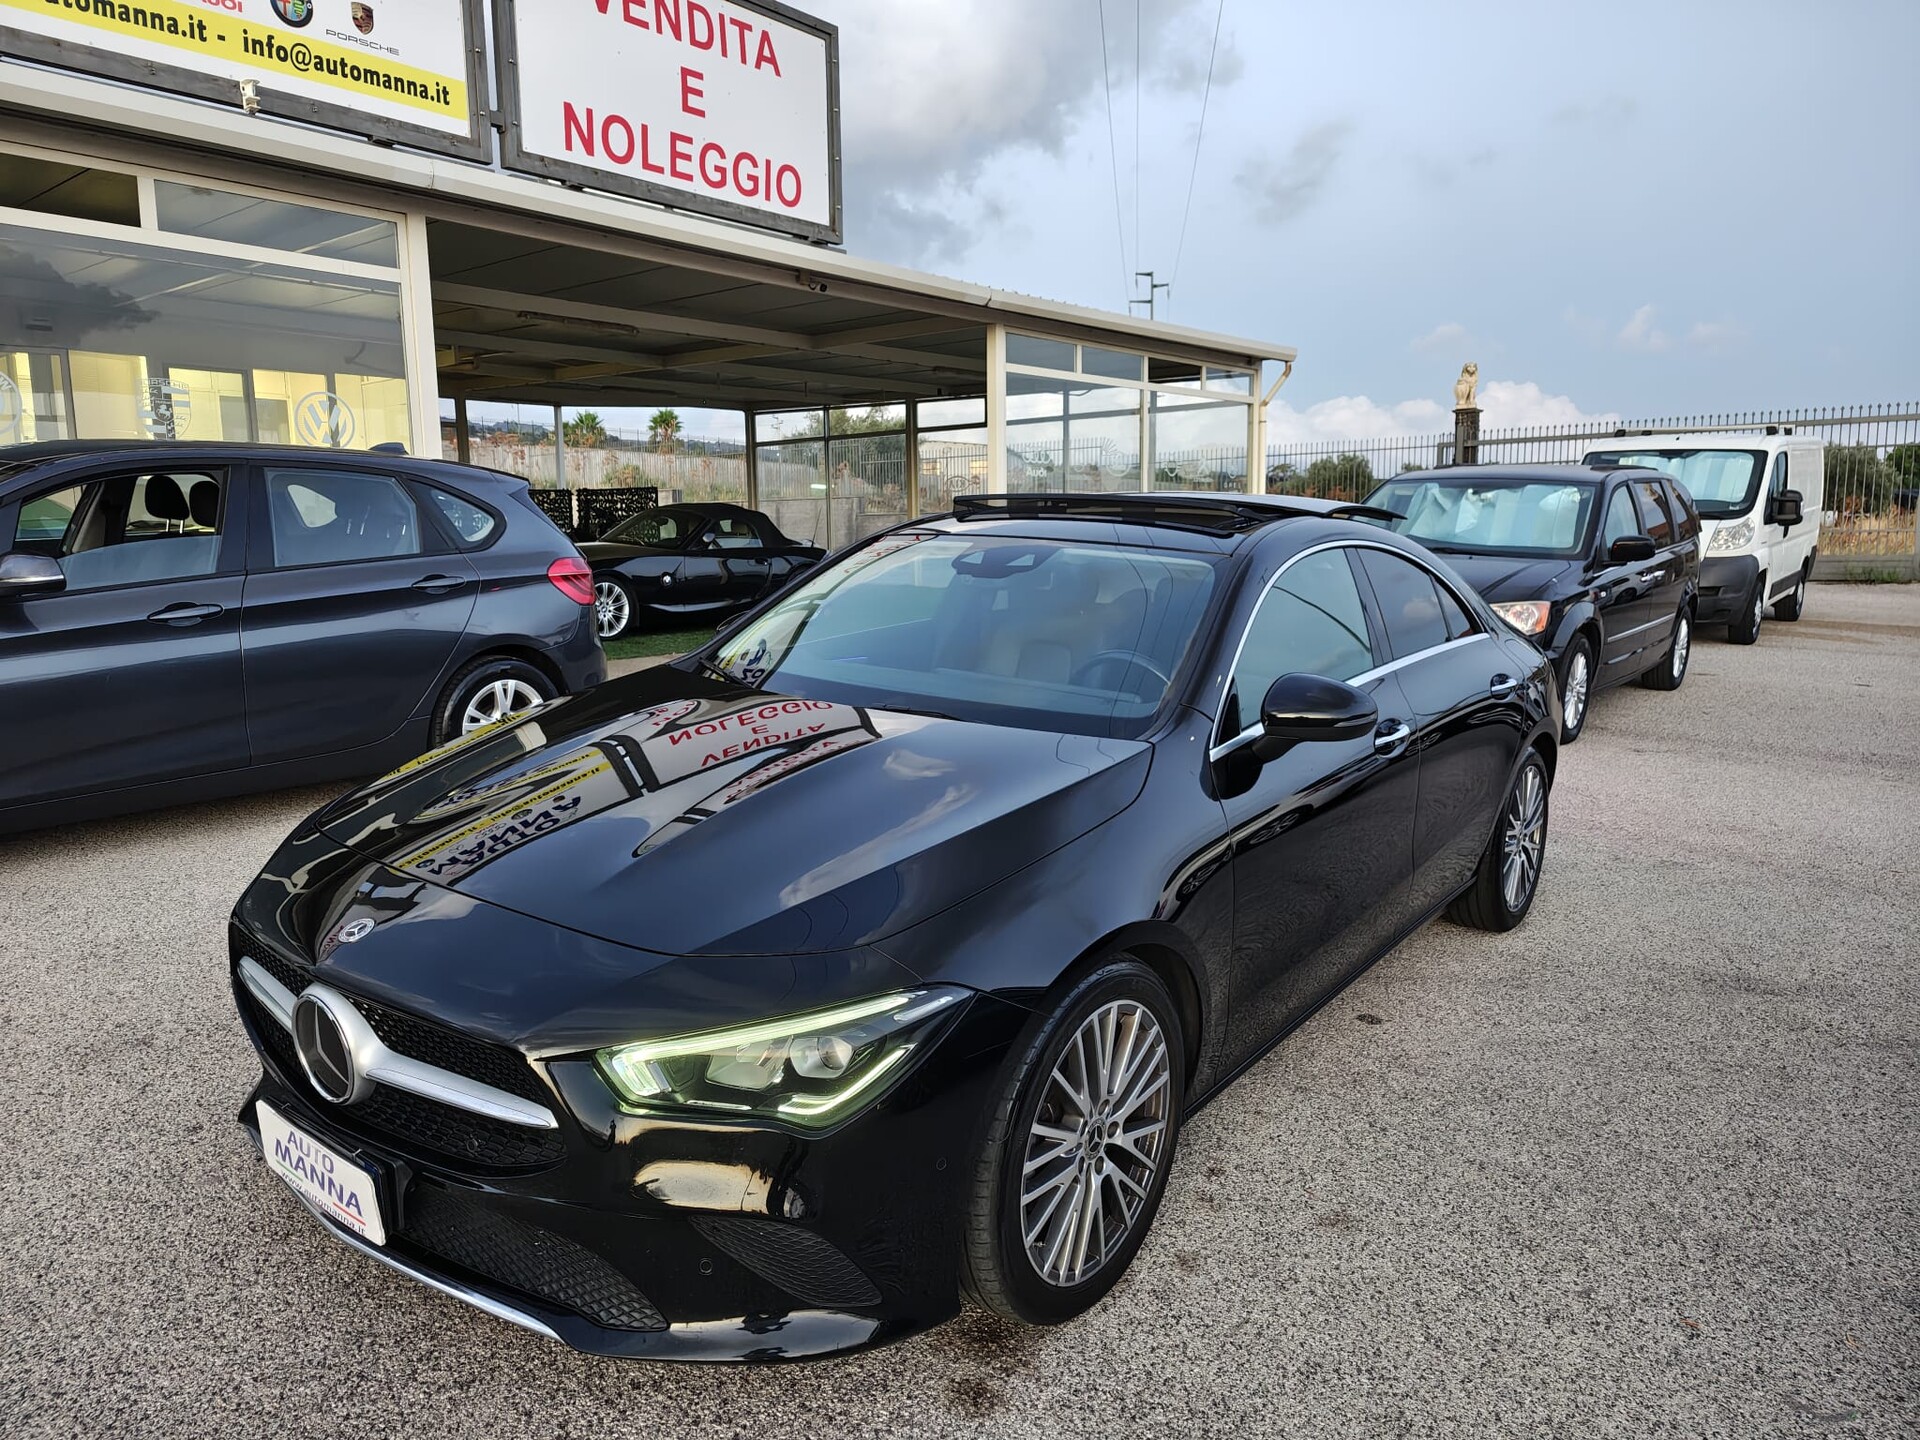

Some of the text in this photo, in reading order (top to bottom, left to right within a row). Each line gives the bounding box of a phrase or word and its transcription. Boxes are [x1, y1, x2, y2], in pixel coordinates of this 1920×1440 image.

[45, 0, 208, 42] omanna.it
[242, 29, 450, 106] info@automanna.it
[326, 29, 400, 56] PORSCHE
[595, 0, 781, 77] ENDITA
[680, 66, 706, 118] E
[563, 101, 802, 208] NOLEGGIO
[274, 1138, 363, 1217] MANNA
[287, 1130, 335, 1174] AUTO
